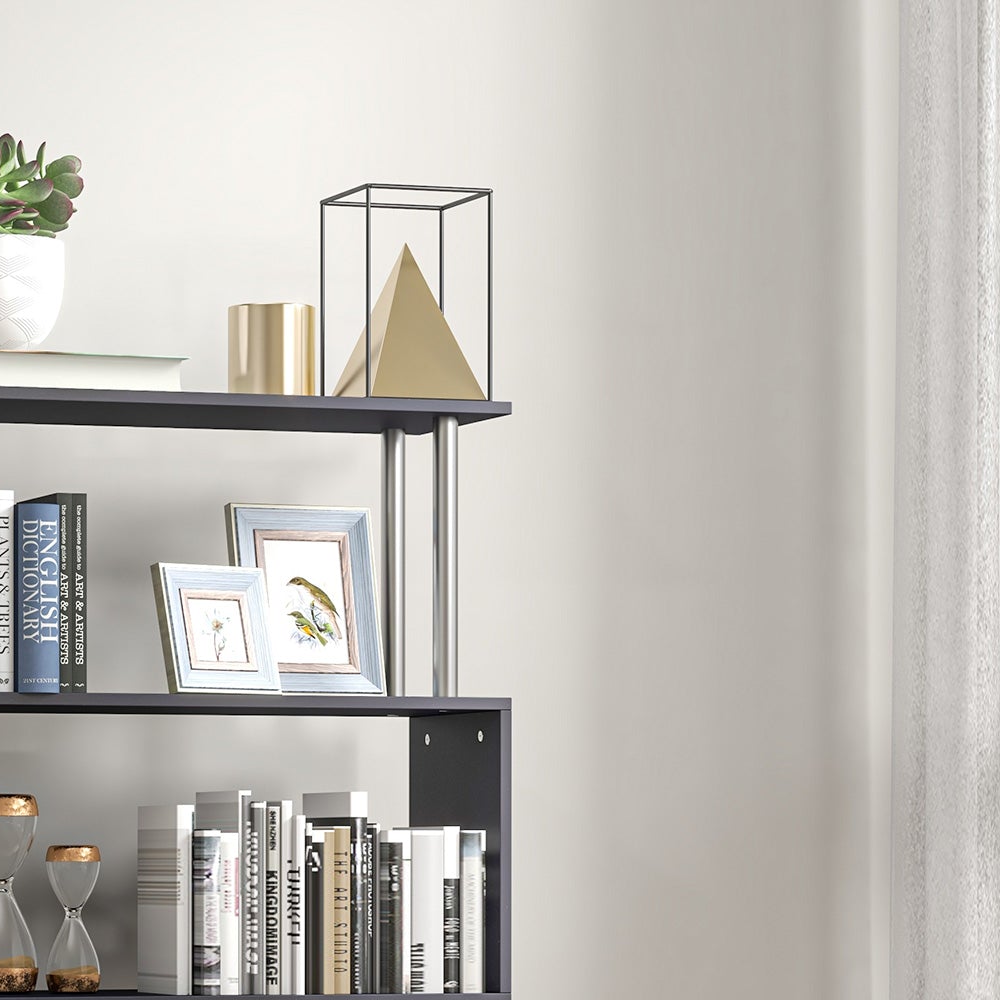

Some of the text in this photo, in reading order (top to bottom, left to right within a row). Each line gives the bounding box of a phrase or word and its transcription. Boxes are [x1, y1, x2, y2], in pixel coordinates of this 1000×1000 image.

[23, 519, 39, 643] DICTIONARY
[40, 519, 58, 643] ENGLISH
[60, 572, 68, 598] ART
[75, 573, 83, 598] ART
[60, 600, 69, 611] &
[75, 601, 84, 611] &
[60, 613, 68, 664] ARTISTS
[75, 613, 83, 665] ARTISTS
[334, 887, 348, 911] ART
